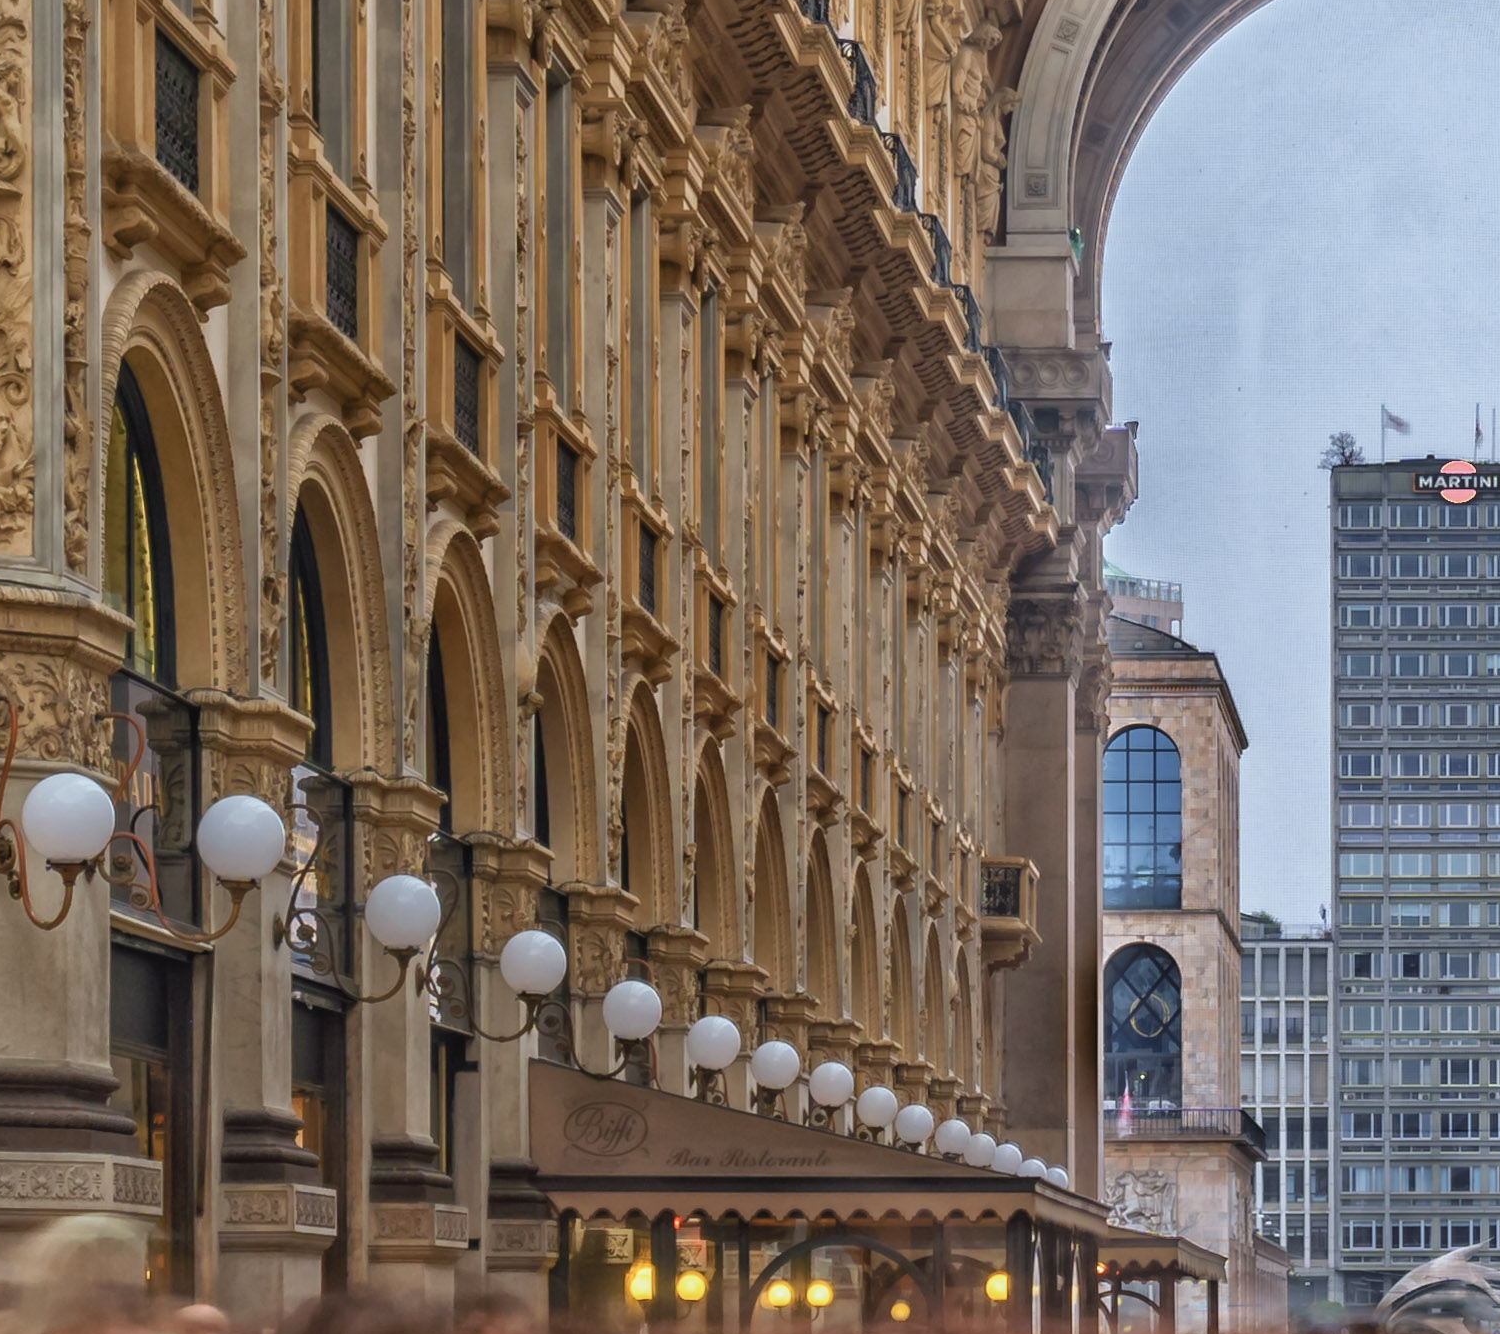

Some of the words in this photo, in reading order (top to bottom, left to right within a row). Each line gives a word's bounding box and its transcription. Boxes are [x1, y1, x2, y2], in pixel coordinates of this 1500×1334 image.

[1418, 475, 1498, 488] MARTINI
[570, 1106, 638, 1152] Biffi
[666, 1148, 713, 1168] Bar
[719, 1148, 834, 1168] Ristorante
